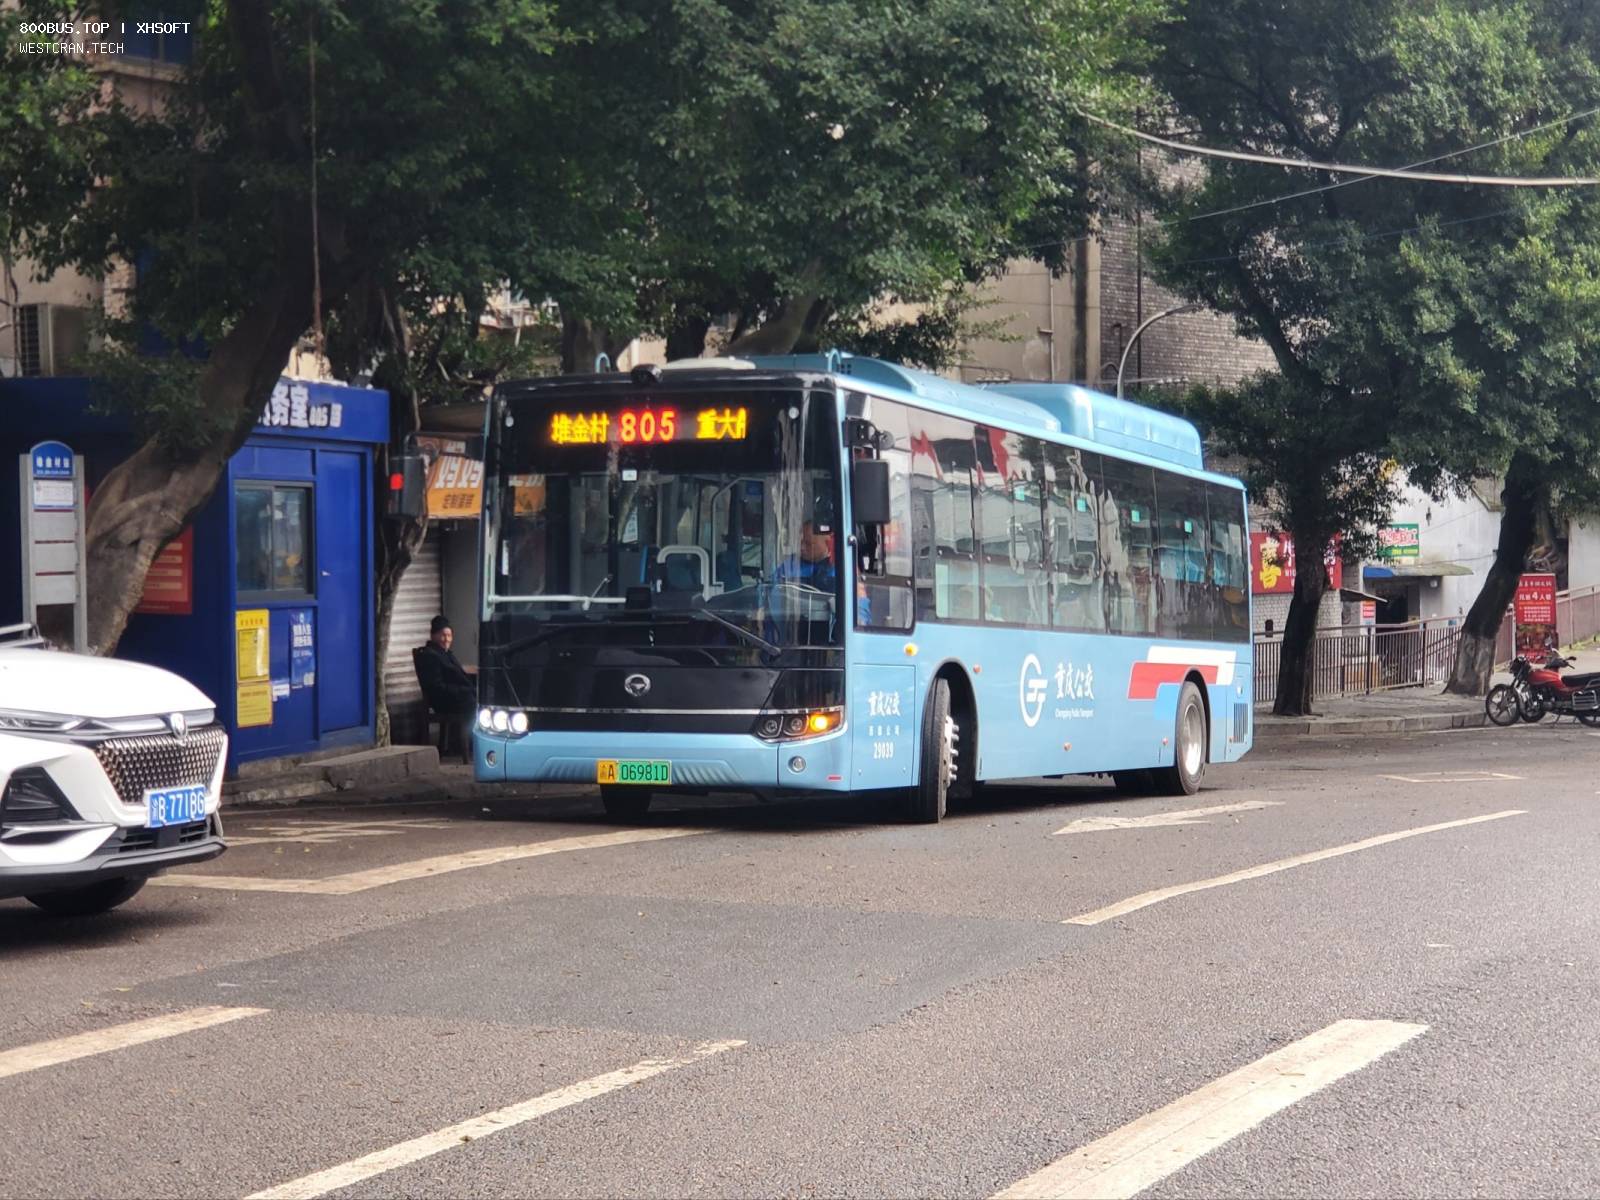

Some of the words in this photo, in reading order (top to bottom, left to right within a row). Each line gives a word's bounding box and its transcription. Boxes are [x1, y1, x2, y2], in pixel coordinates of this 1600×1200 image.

[257, 382, 309, 428] 务室
[550, 411, 609, 444] 堆金村
[620, 408, 675, 441] 805
[621, 764, 669, 780] 06981D
